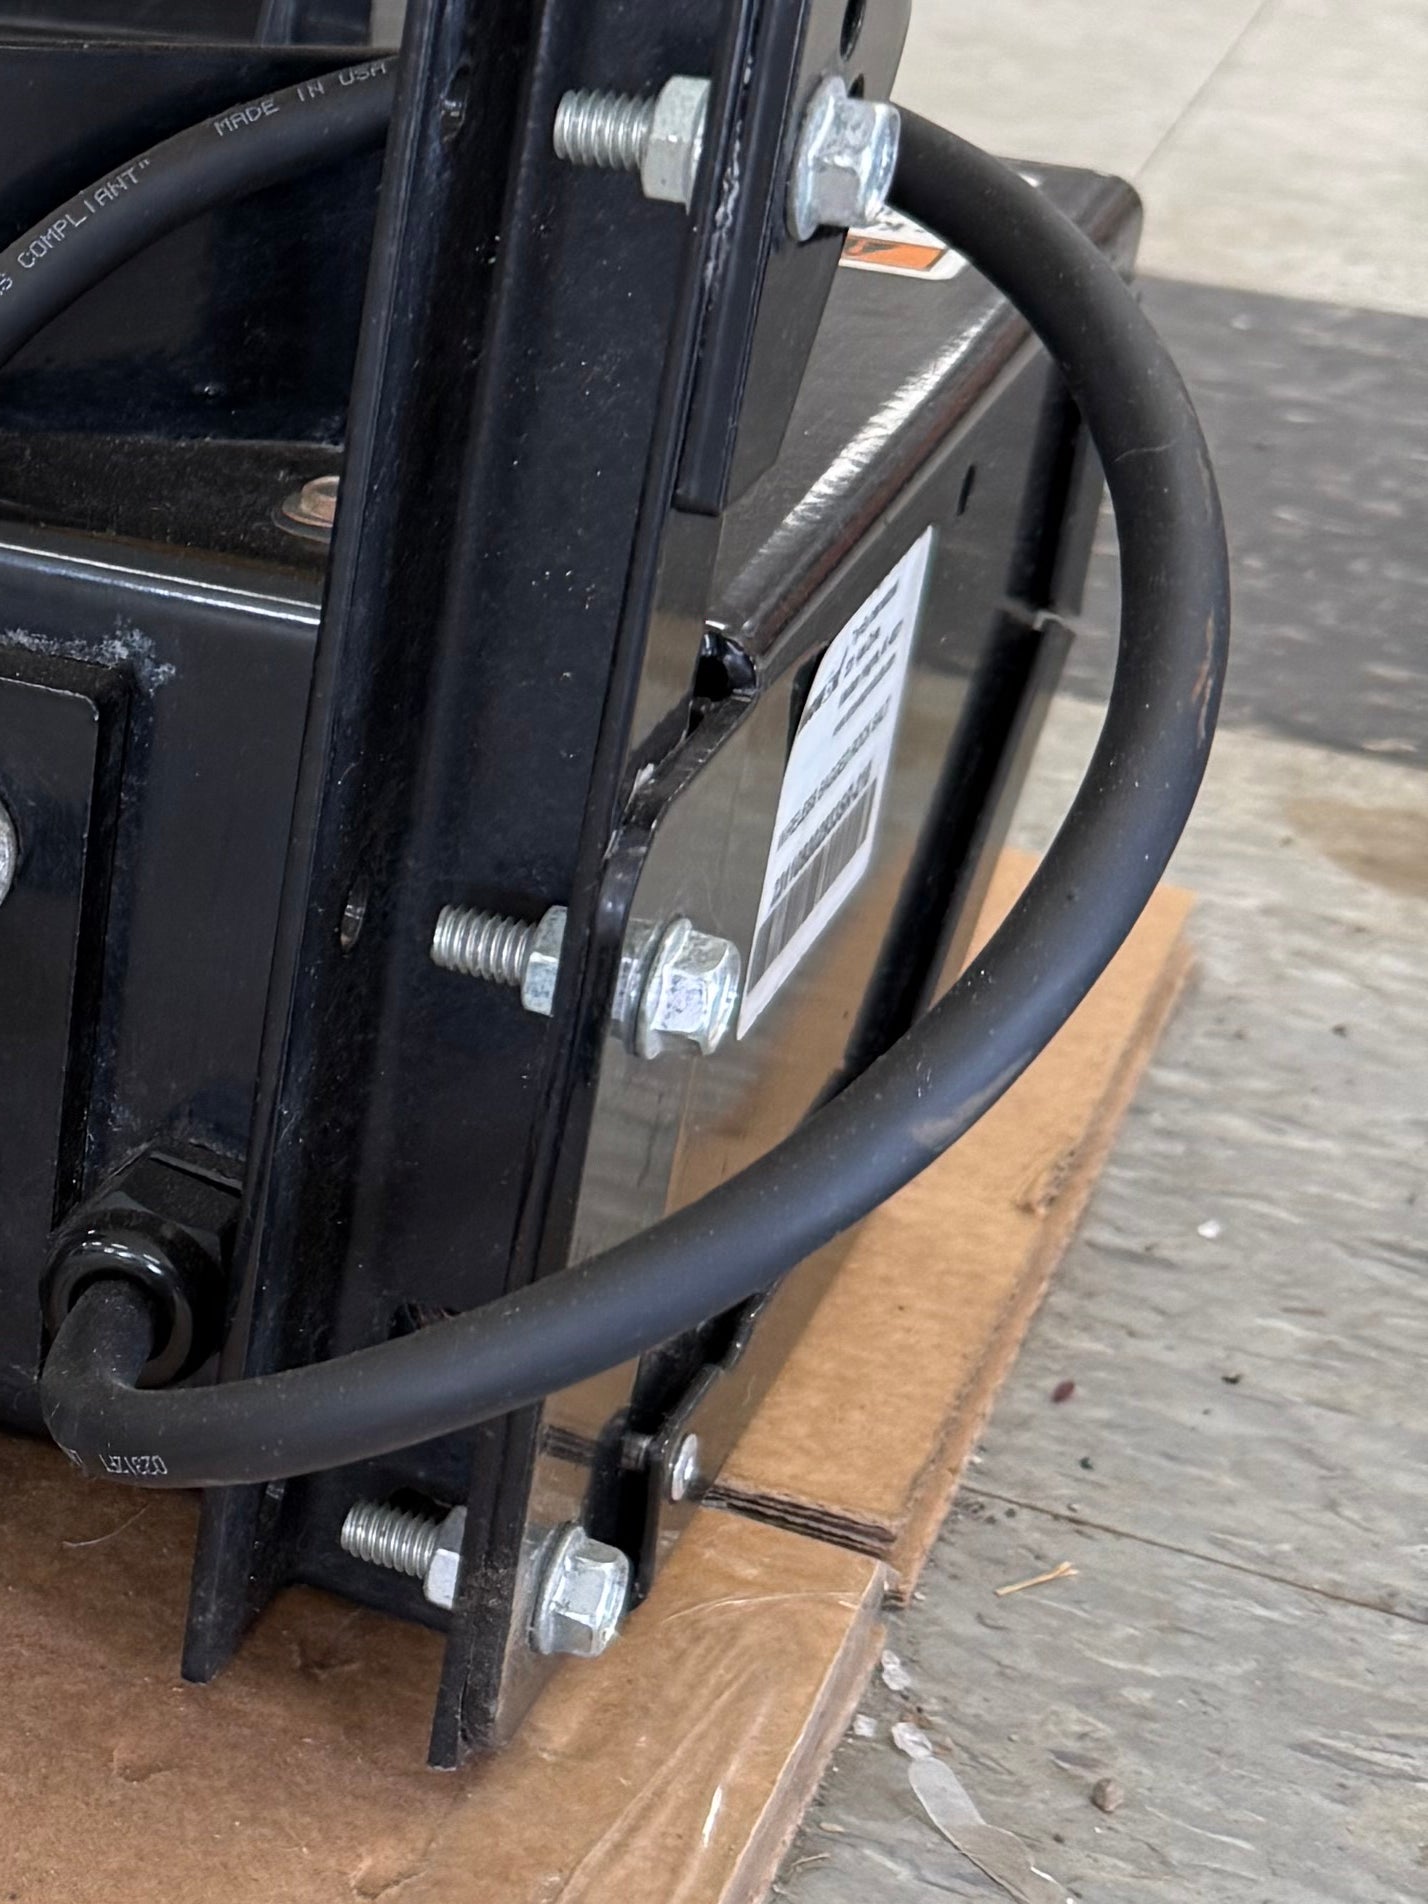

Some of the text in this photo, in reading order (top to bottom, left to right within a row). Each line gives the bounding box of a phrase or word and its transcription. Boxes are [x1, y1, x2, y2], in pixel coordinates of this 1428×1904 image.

[213, 97, 280, 137] MADE
[296, 80, 325, 103] IN
[338, 61, 388, 87] USA
